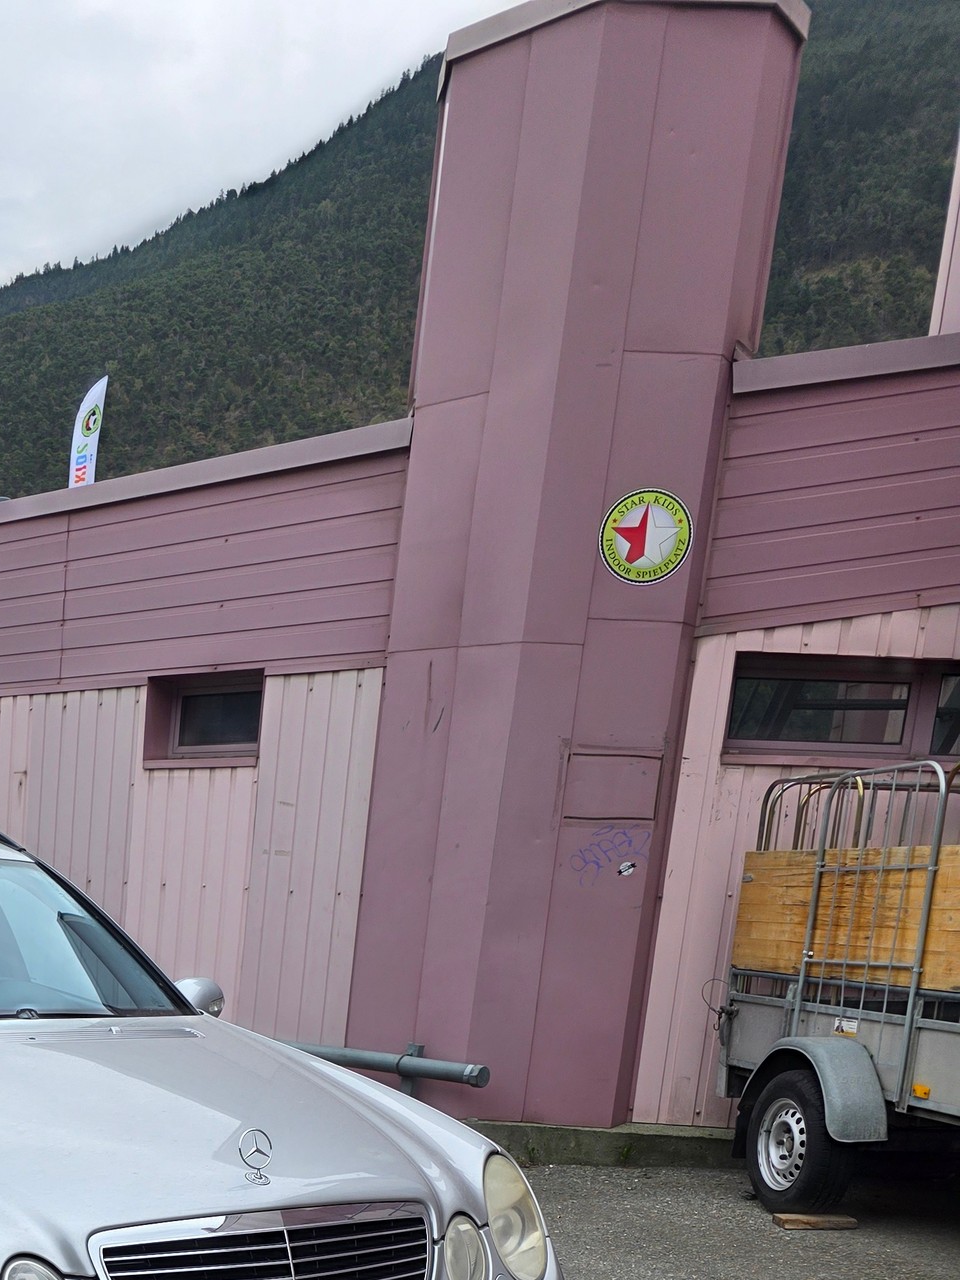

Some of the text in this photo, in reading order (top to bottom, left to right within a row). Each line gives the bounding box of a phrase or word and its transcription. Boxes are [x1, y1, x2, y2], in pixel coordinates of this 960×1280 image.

[74, 443, 88, 484] KIDS
[618, 495, 680, 517] STAR KIDS
[606, 538, 686, 578] INDOOR SPIELPLATZ
